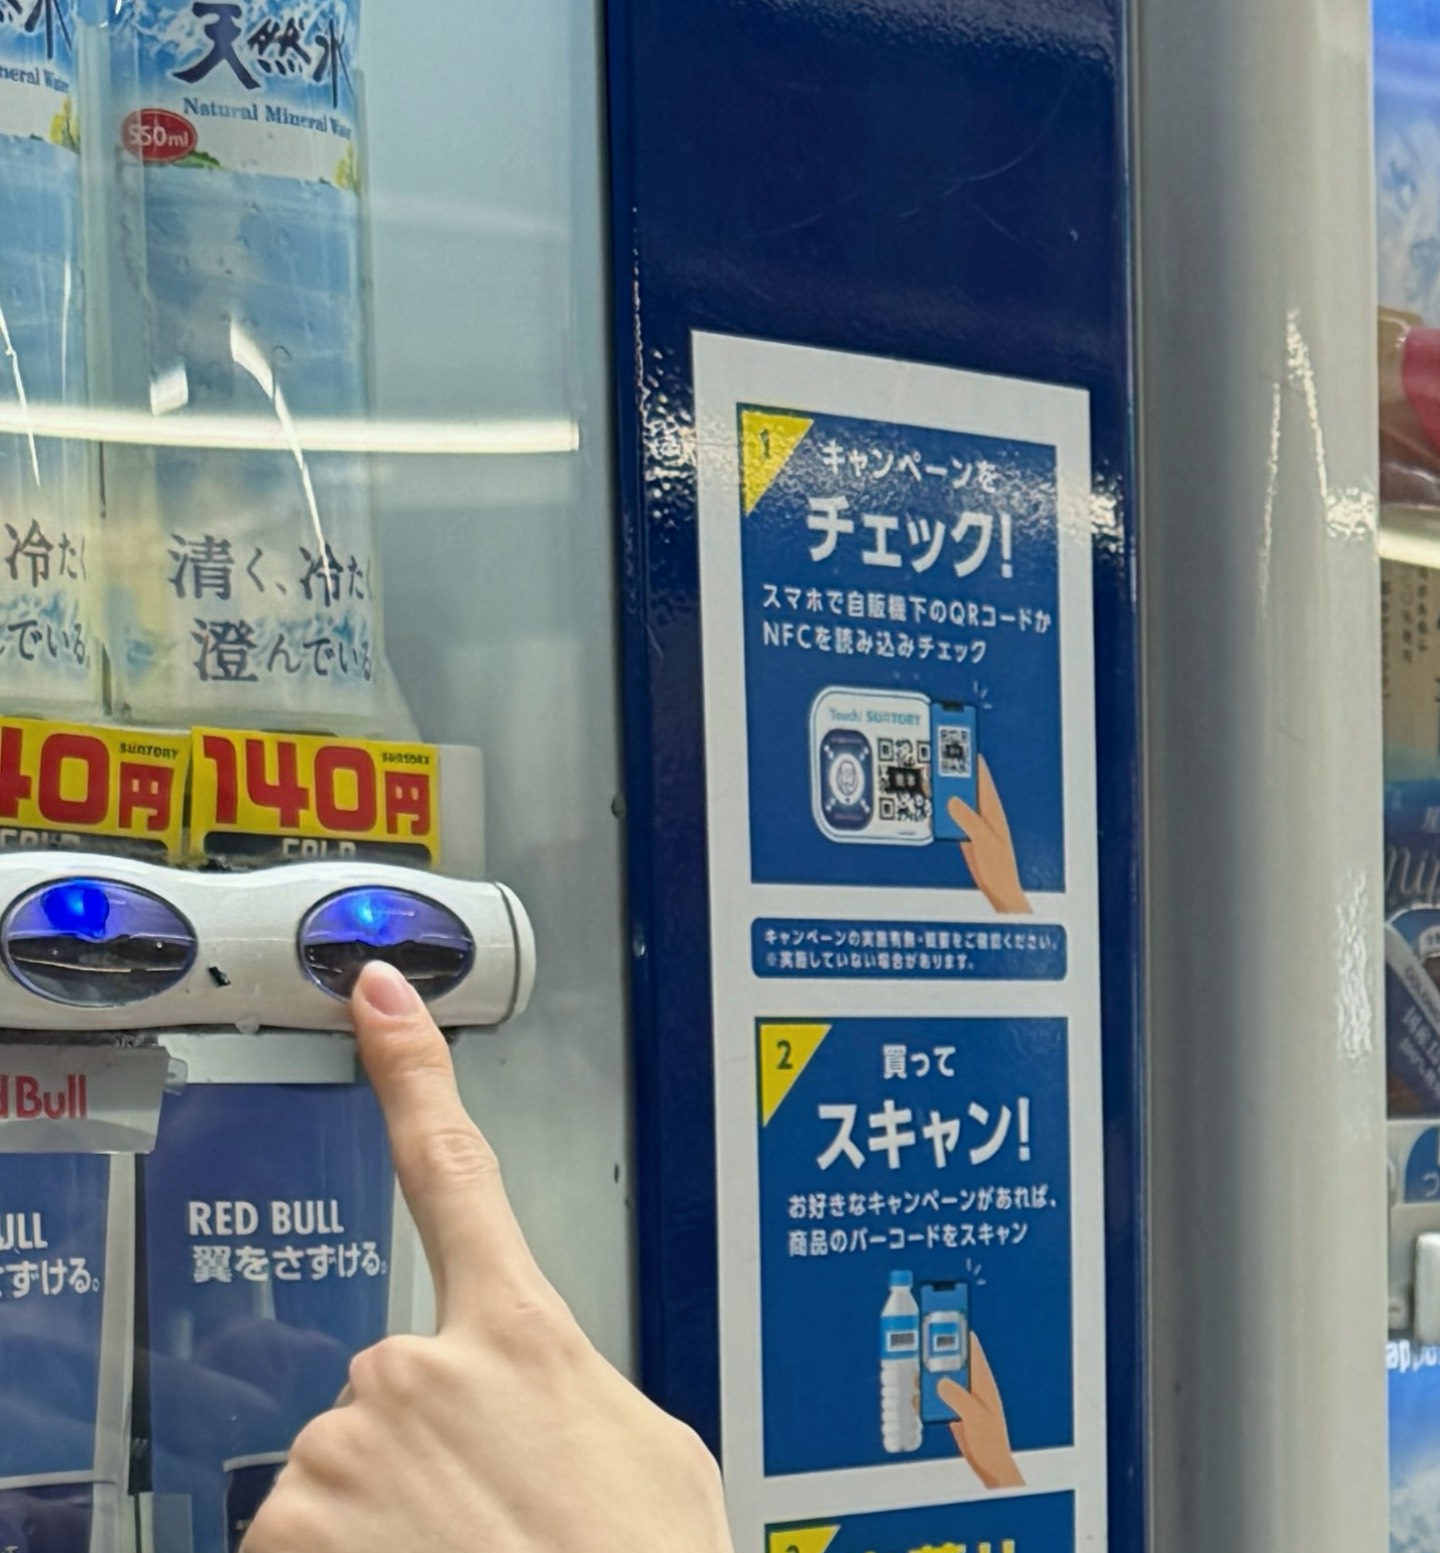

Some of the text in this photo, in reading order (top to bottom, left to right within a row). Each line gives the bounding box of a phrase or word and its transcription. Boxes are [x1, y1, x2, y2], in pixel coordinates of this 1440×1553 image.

[128, 123, 190, 149] 550ml
[183, 98, 258, 121] Natural
[266, 105, 327, 133] Mineral
[821, 440, 999, 494] キャンペーンを
[805, 494, 1015, 580] チェック!
[762, 622, 988, 665] NFCを読み込みチェック
[203, 734, 430, 836] 140円
[775, 1039, 794, 1071] 2
[882, 1042, 957, 1081] 買って
[816, 1096, 1031, 1171] スキャン!
[188, 1199, 345, 1237] RED BULL
[787, 1221, 1028, 1258] 商品のバーコードをスキャン
[193, 1241, 388, 1285] 翼をさずける。
